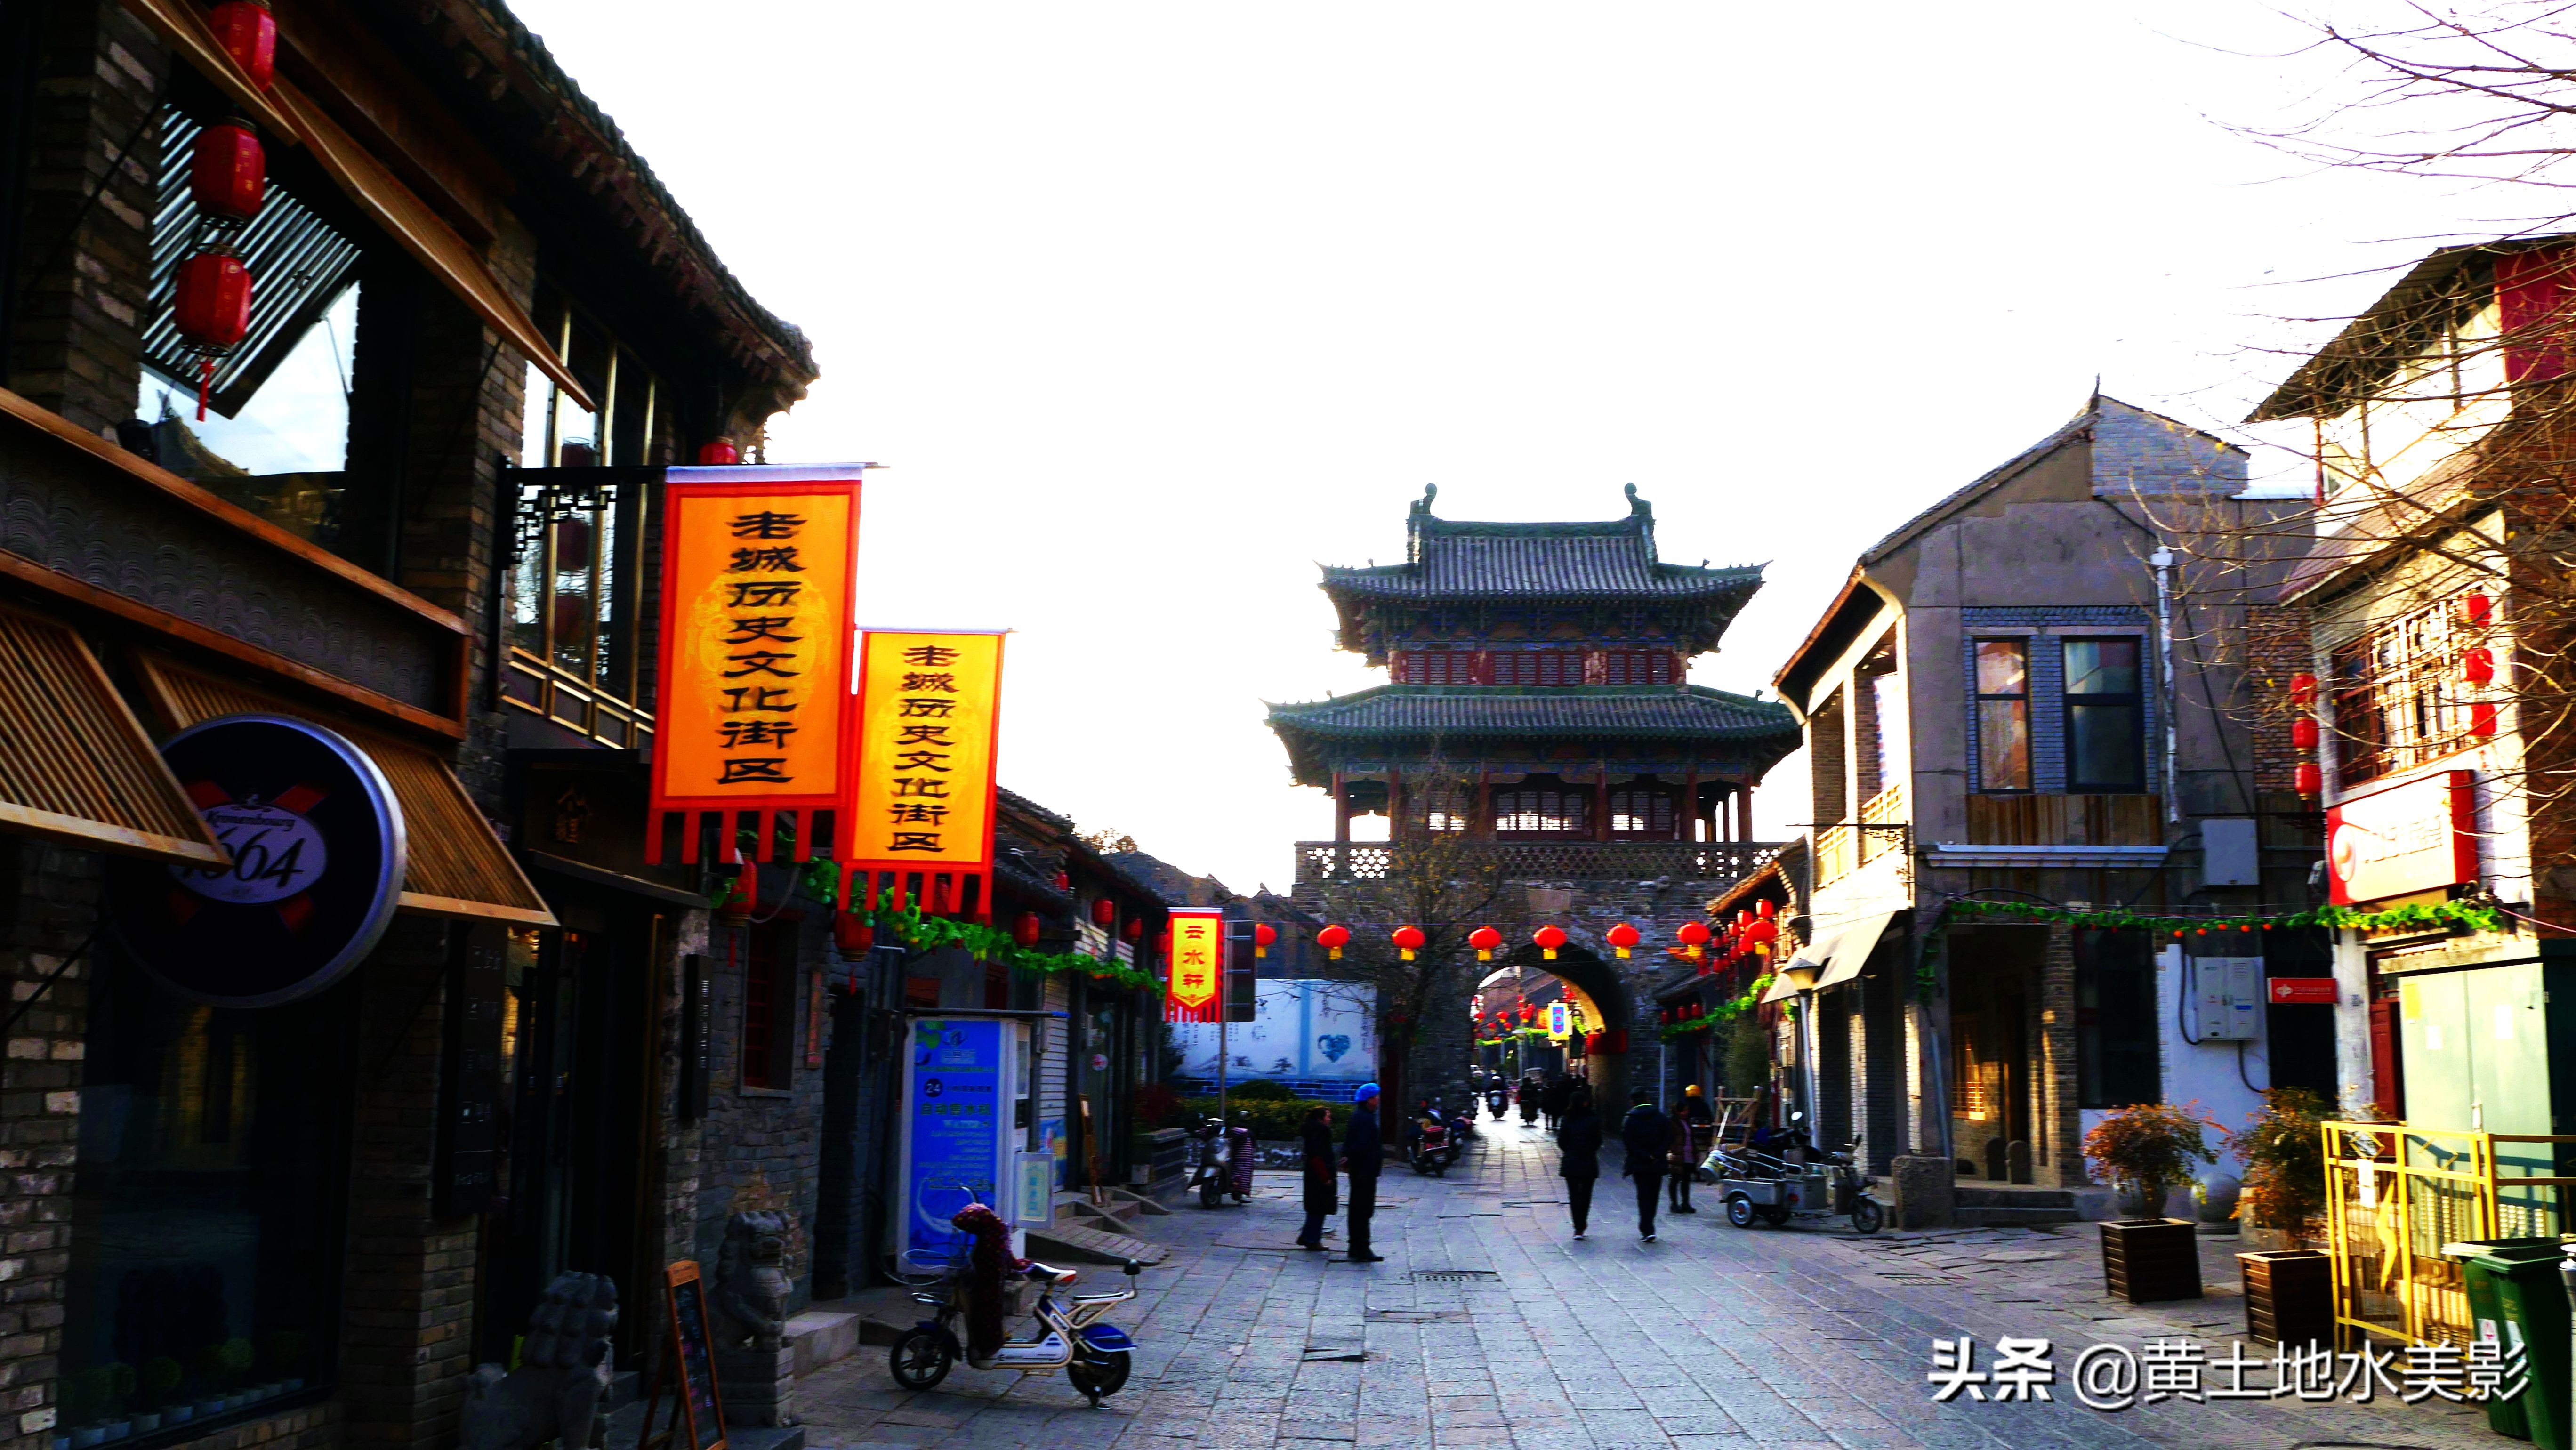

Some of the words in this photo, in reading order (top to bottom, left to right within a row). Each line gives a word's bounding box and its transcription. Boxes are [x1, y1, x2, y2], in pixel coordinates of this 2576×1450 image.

[715, 510, 806, 784] 老城历史文化街区
[886, 645, 960, 853] 老城历史文化街区
[926, 1083, 941, 1093] 24
